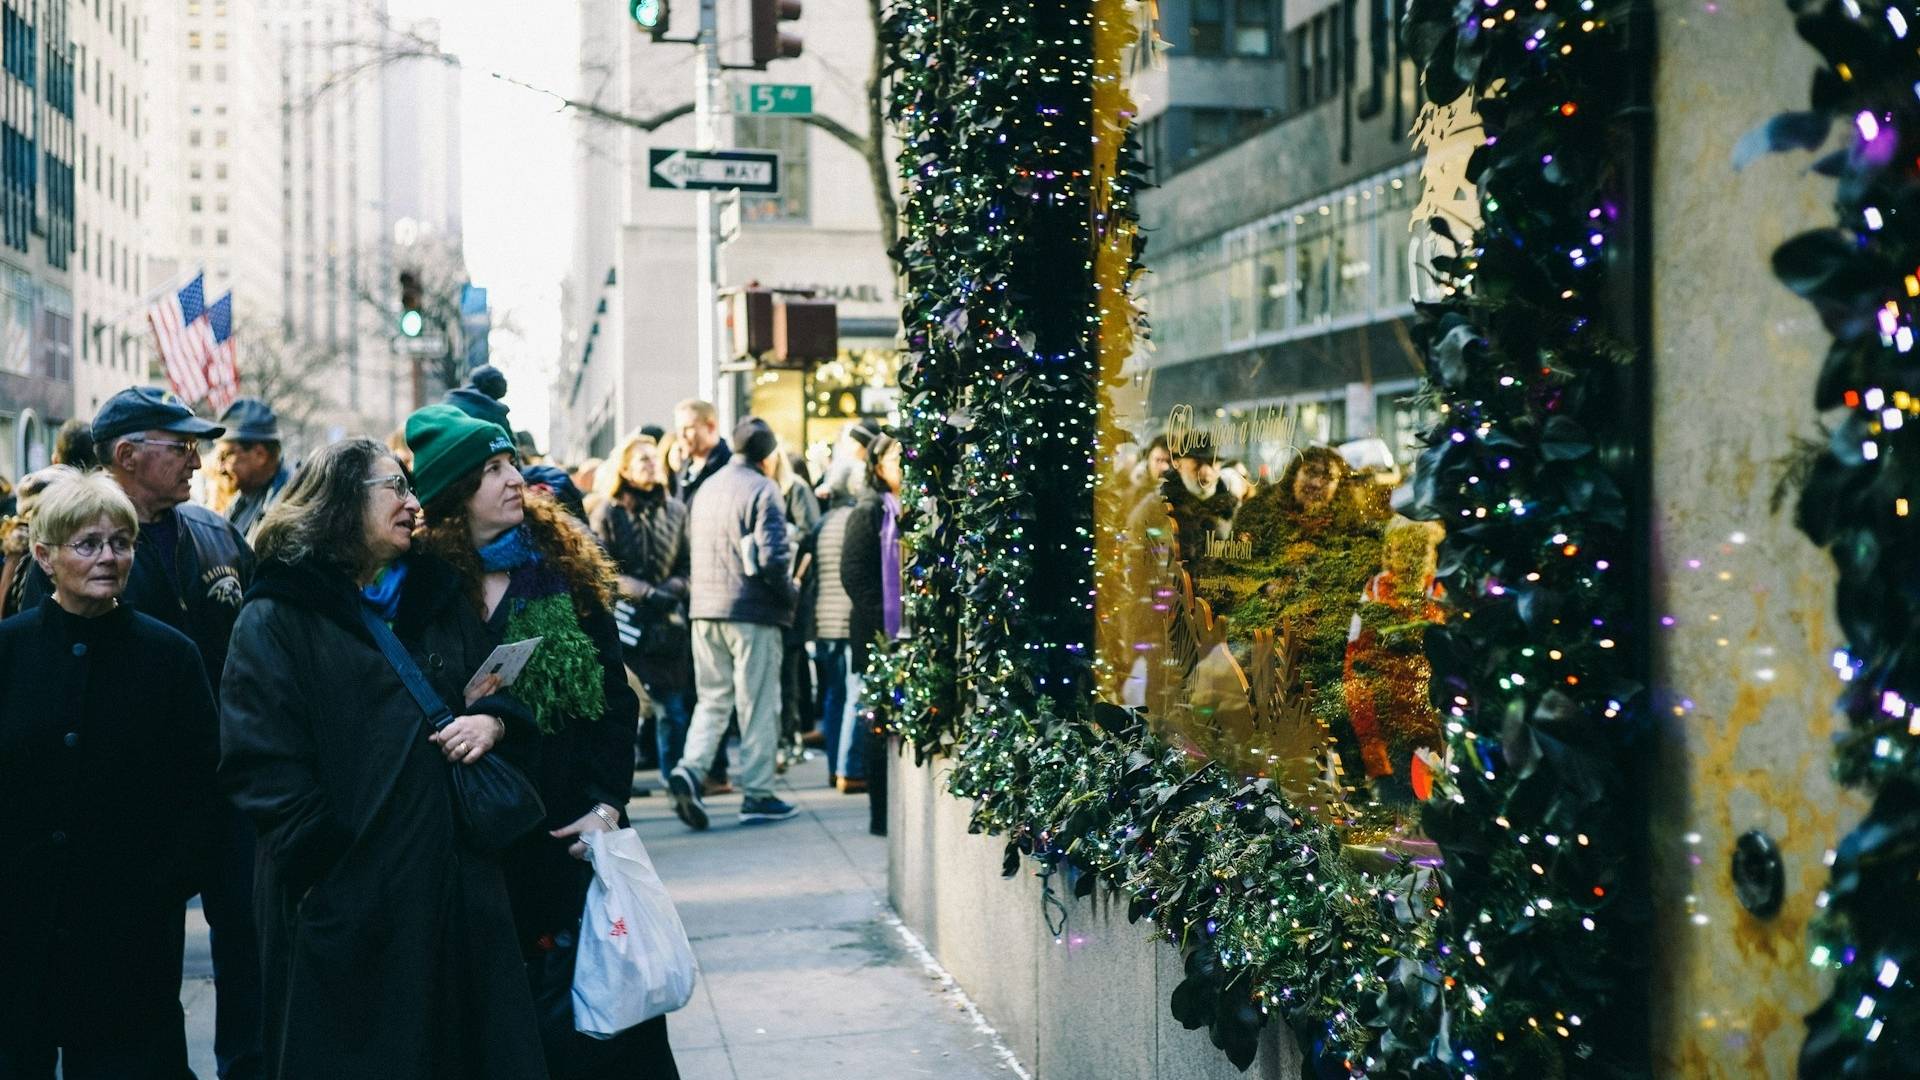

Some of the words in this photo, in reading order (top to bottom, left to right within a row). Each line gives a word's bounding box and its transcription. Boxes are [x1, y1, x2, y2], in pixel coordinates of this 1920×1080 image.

[757, 86, 775, 112] 5
[667, 161, 703, 177] ONE
[724, 165, 763, 179] WAY
[1167, 403, 1208, 466] Once
